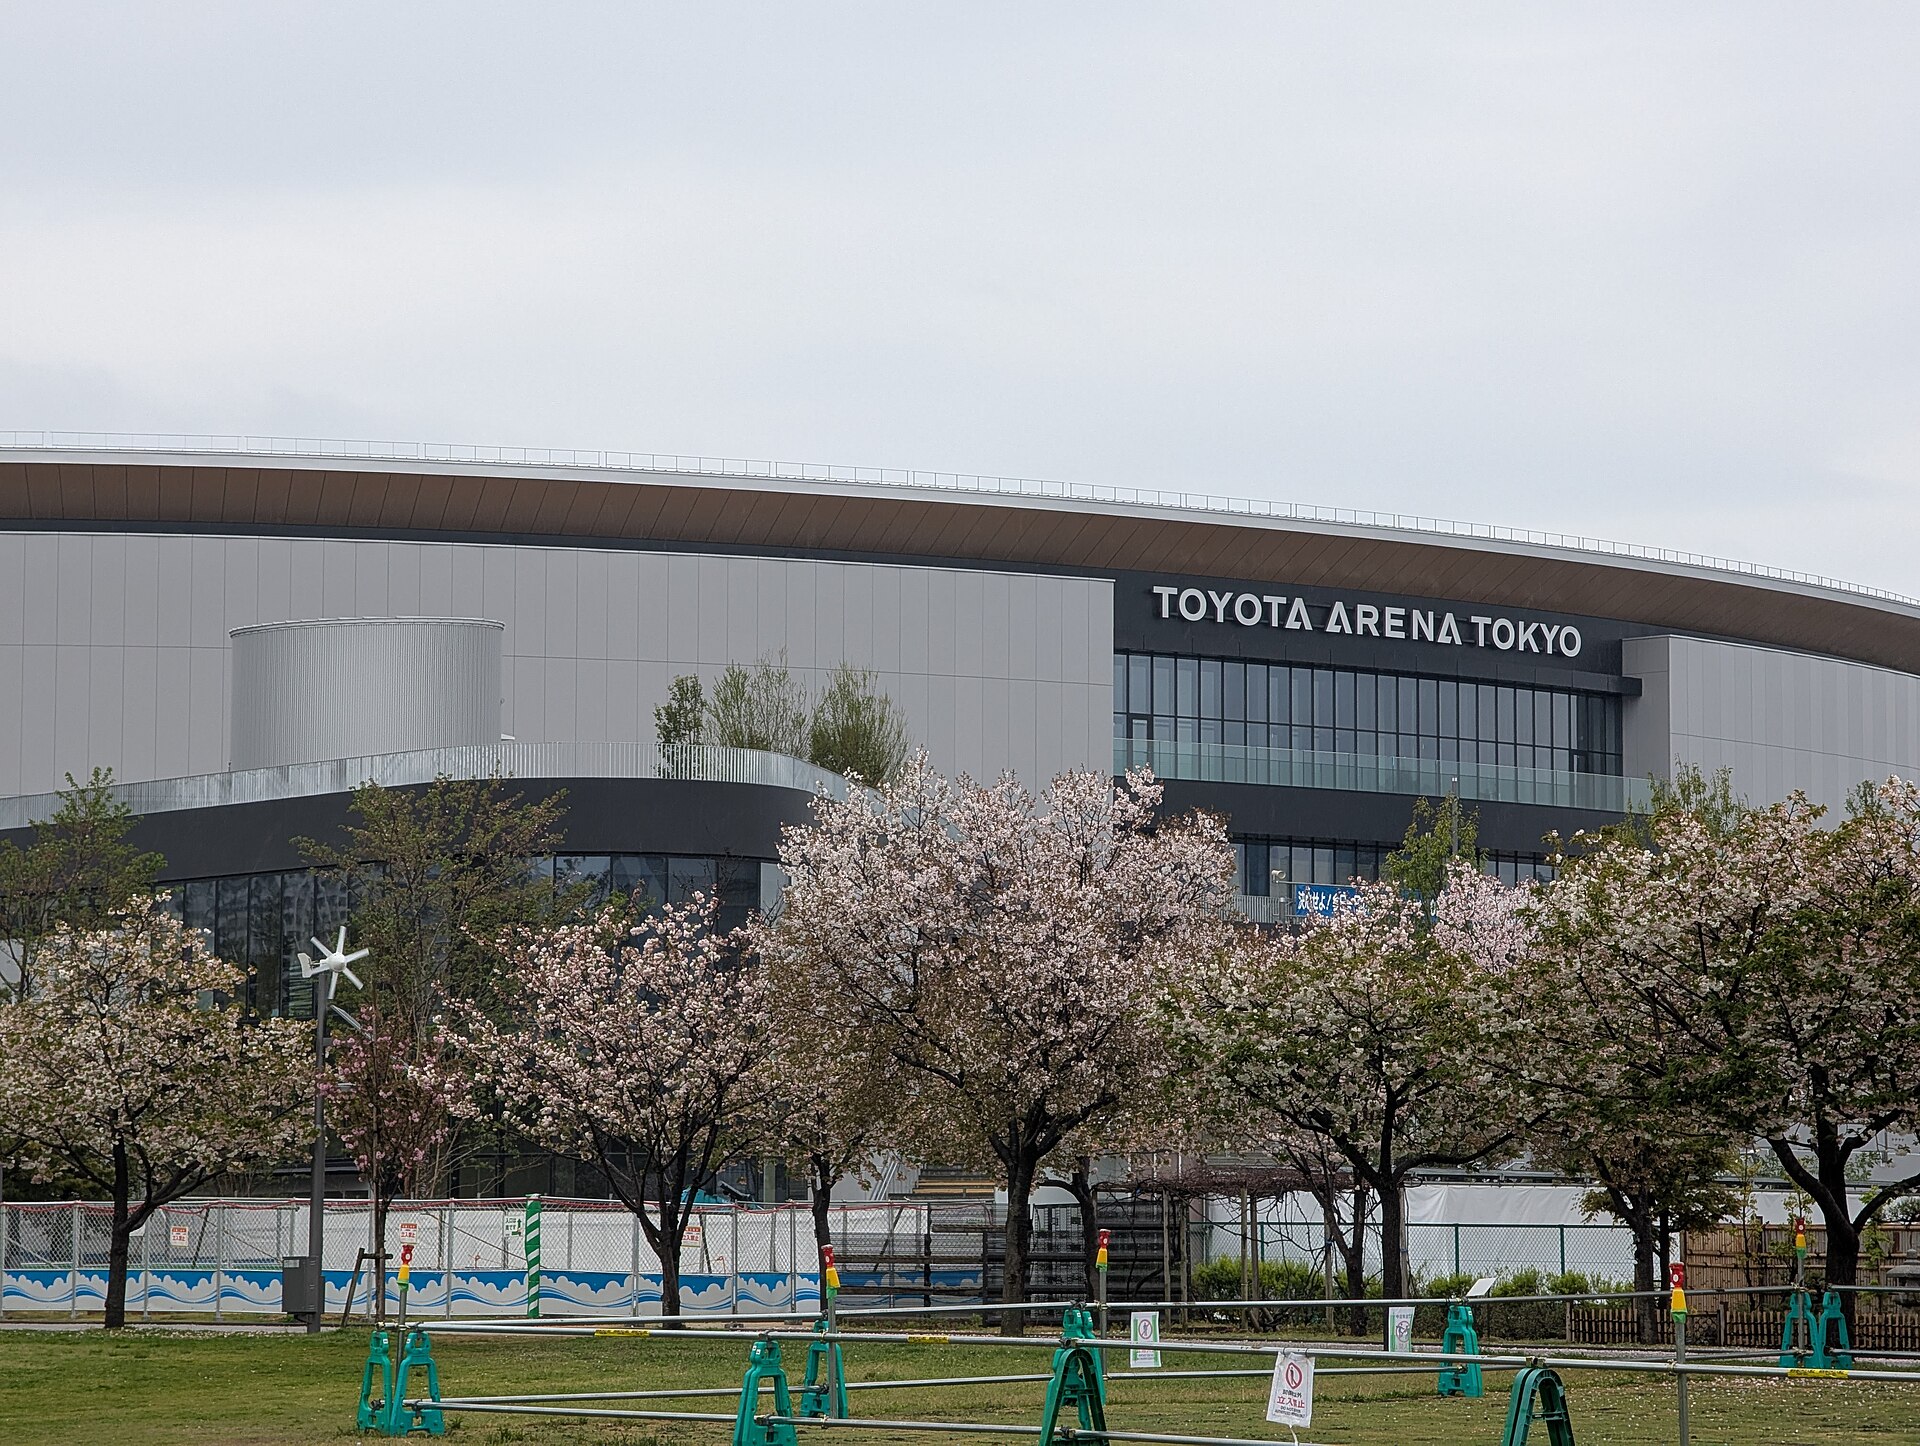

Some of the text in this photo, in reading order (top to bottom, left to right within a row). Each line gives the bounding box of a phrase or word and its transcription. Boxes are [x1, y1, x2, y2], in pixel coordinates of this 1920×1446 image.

[1153, 586, 1582, 658] TOYOTA ARENA TOKYO
